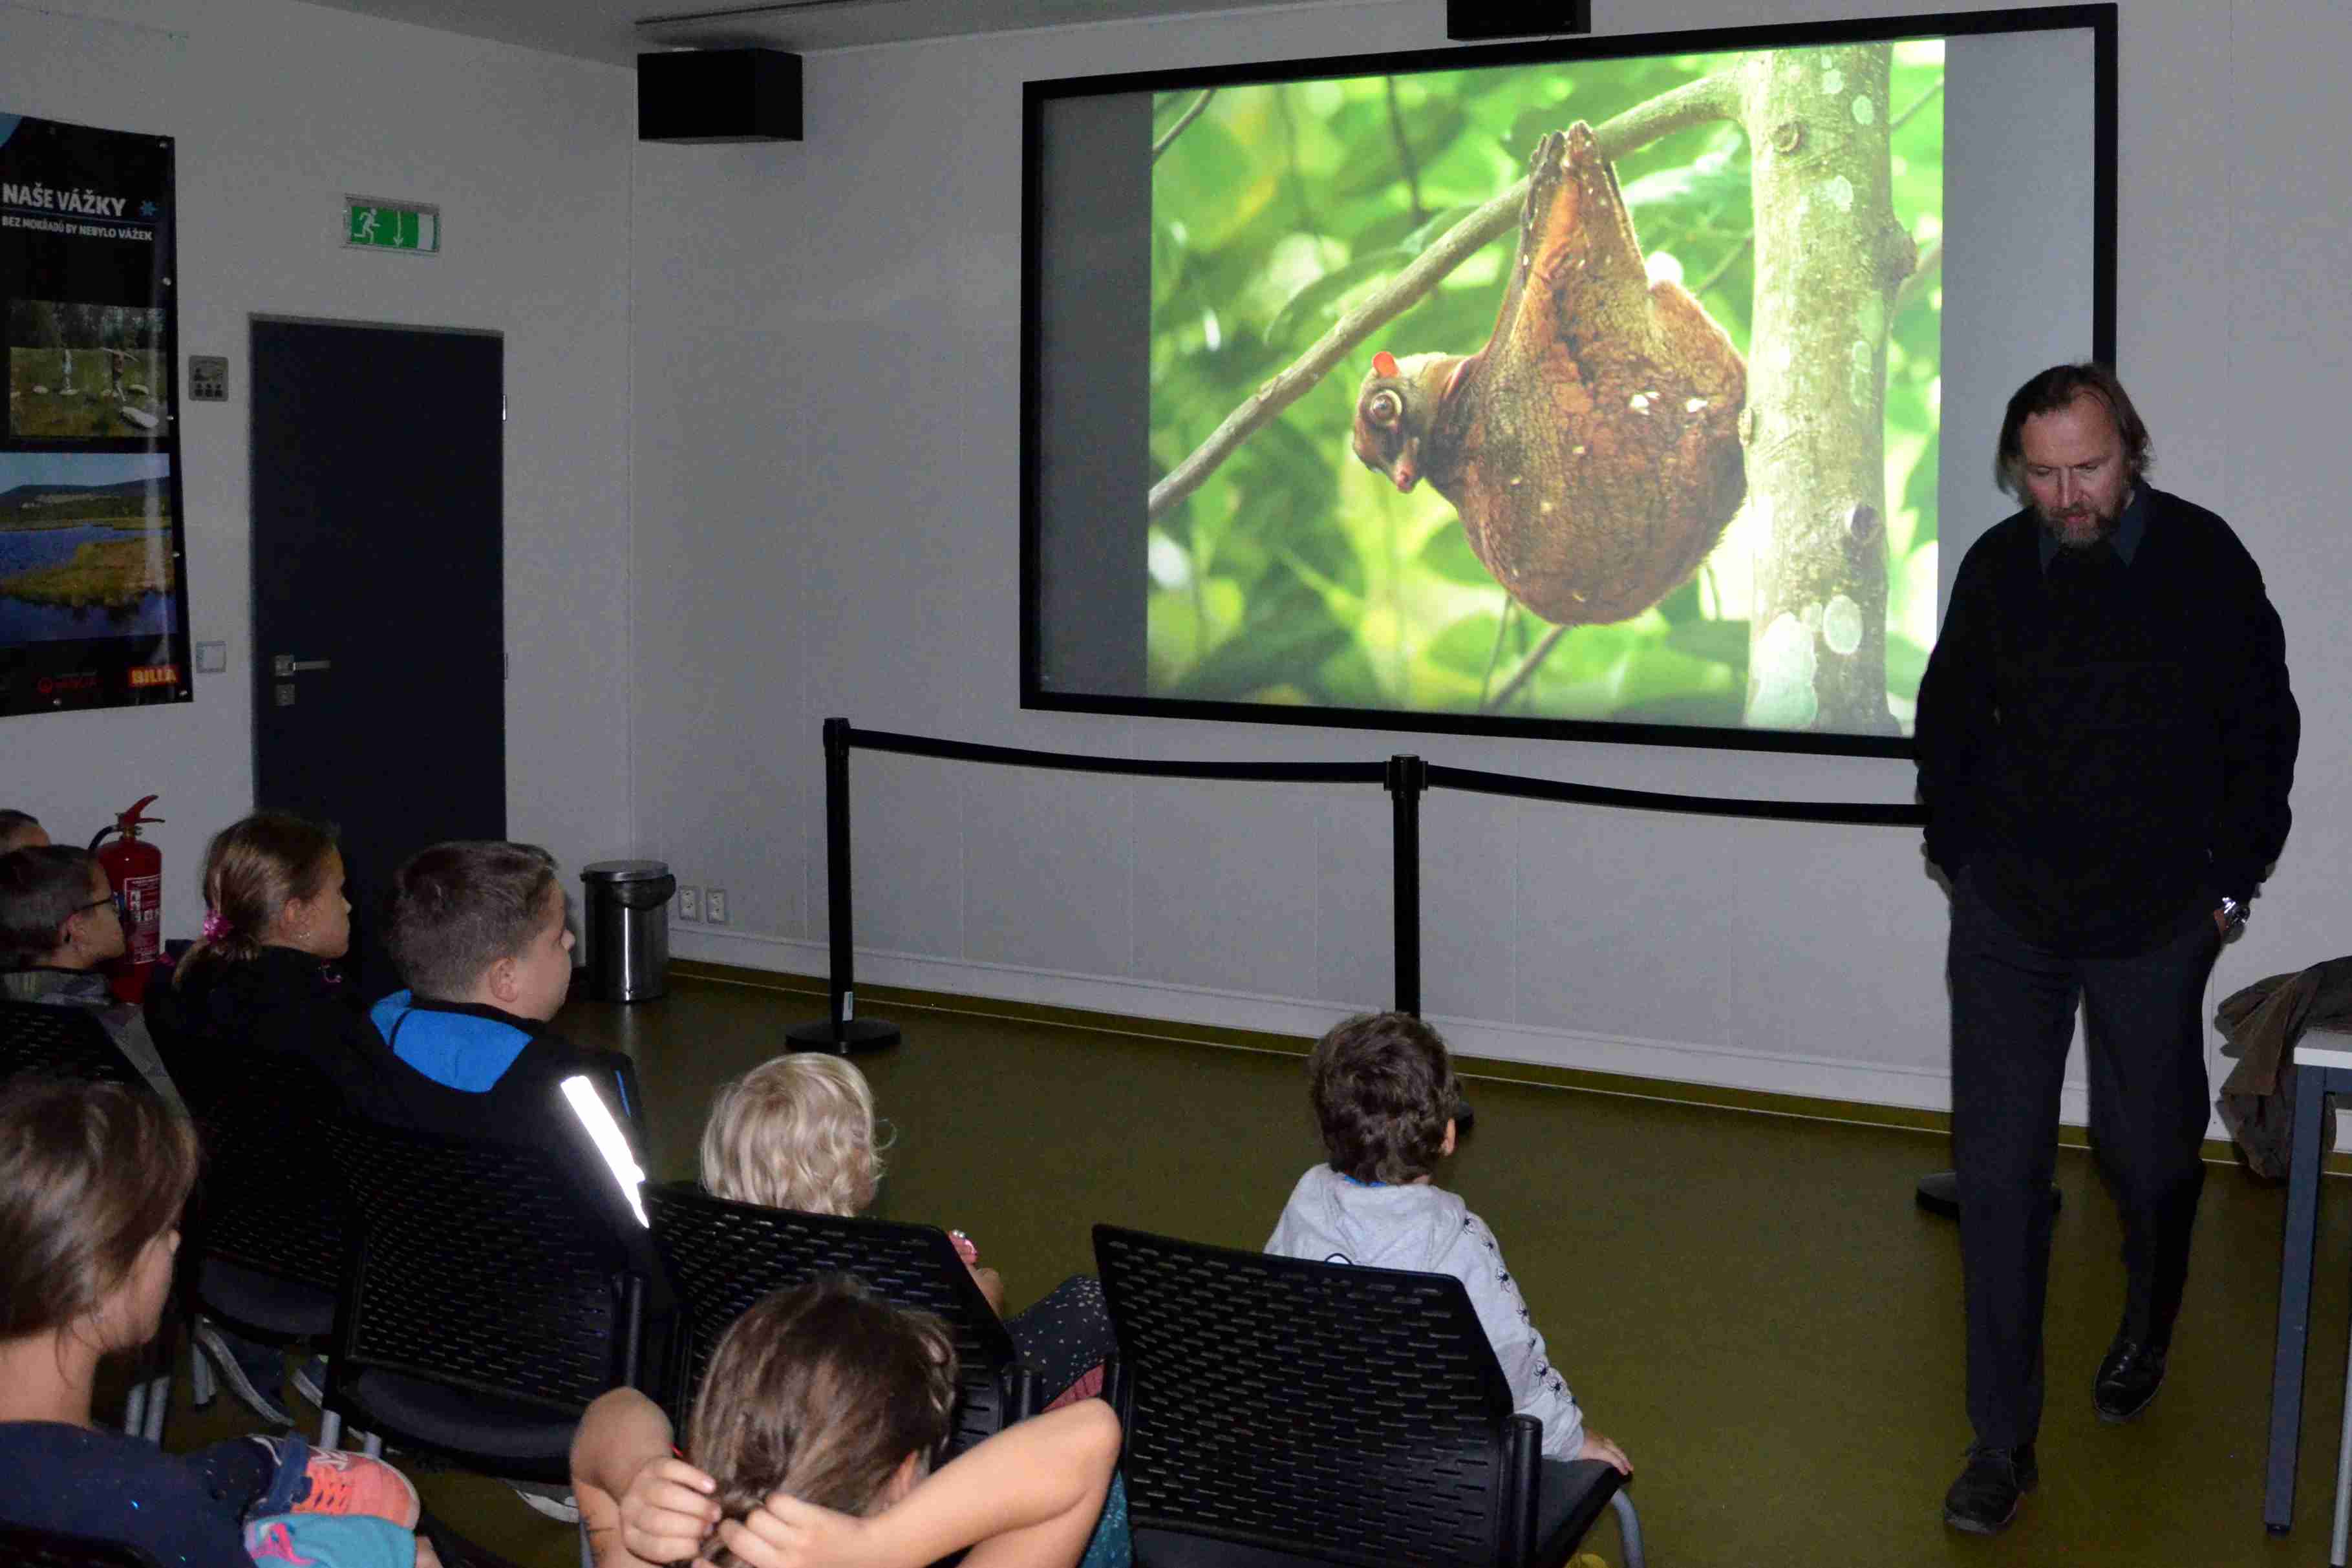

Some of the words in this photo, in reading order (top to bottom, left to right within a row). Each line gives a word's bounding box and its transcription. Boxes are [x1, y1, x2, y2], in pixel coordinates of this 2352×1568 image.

[3, 182, 54, 208] NAŠE
[57, 187, 126, 217] VÁŽKY
[2, 215, 21, 228] BEZ
[65, 223, 78, 235] BY
[79, 225, 116, 238] NEBYLO
[118, 228, 153, 241] VÁŽEK
[131, 668, 177, 684] BILLA
